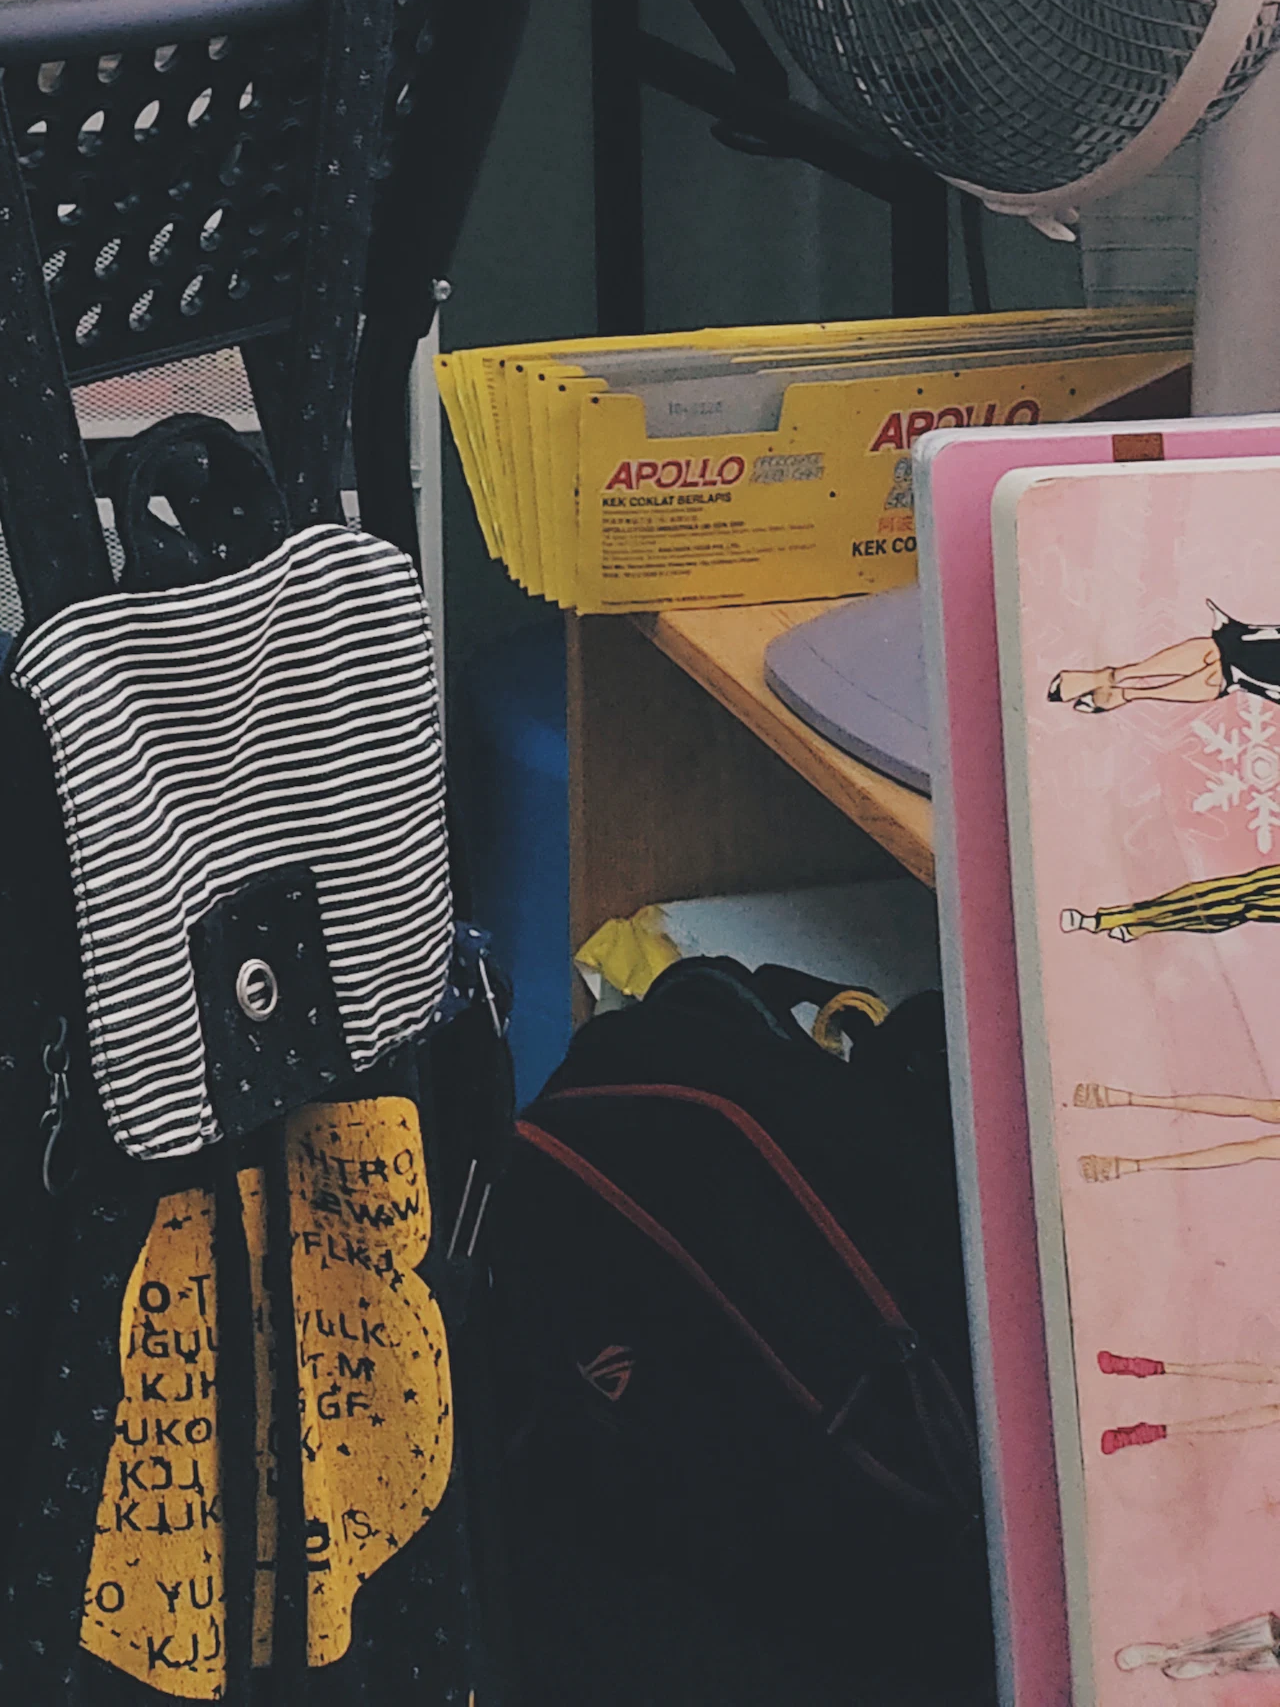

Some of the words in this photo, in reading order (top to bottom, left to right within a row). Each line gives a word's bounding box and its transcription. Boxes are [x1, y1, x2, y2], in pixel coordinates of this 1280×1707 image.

[605, 455, 746, 490] APOLLO
[602, 495, 625, 507] KEK
[629, 495, 675, 507] COKLAT
[677, 492, 732, 505] BERLAPIS
[851, 539, 887, 557] KEK
